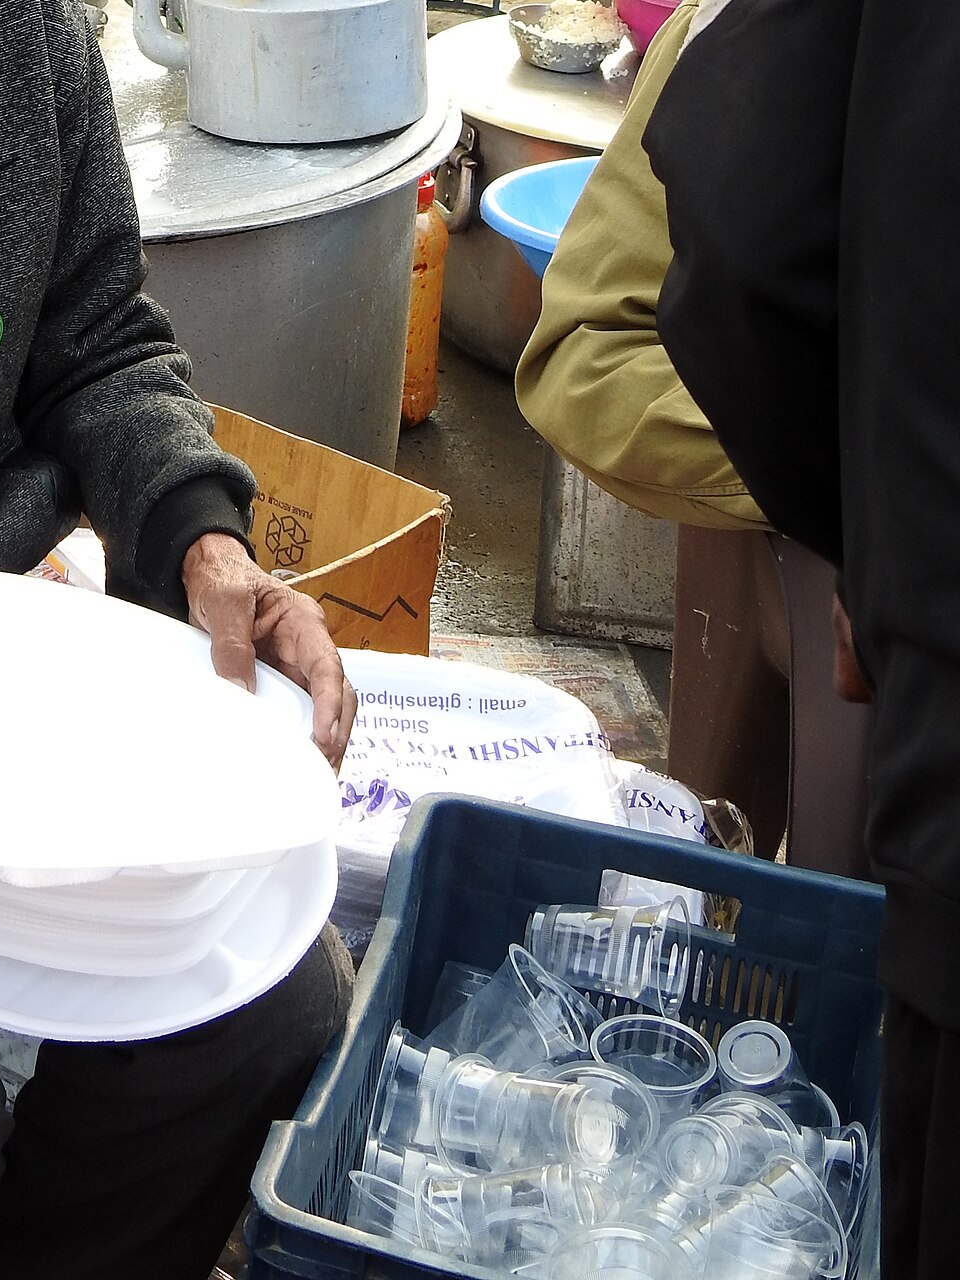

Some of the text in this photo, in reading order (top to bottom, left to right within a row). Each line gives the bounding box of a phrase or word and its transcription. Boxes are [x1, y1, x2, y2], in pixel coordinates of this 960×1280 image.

[479, 697, 527, 715] email
[354, 714, 429, 734] Sidcul H
